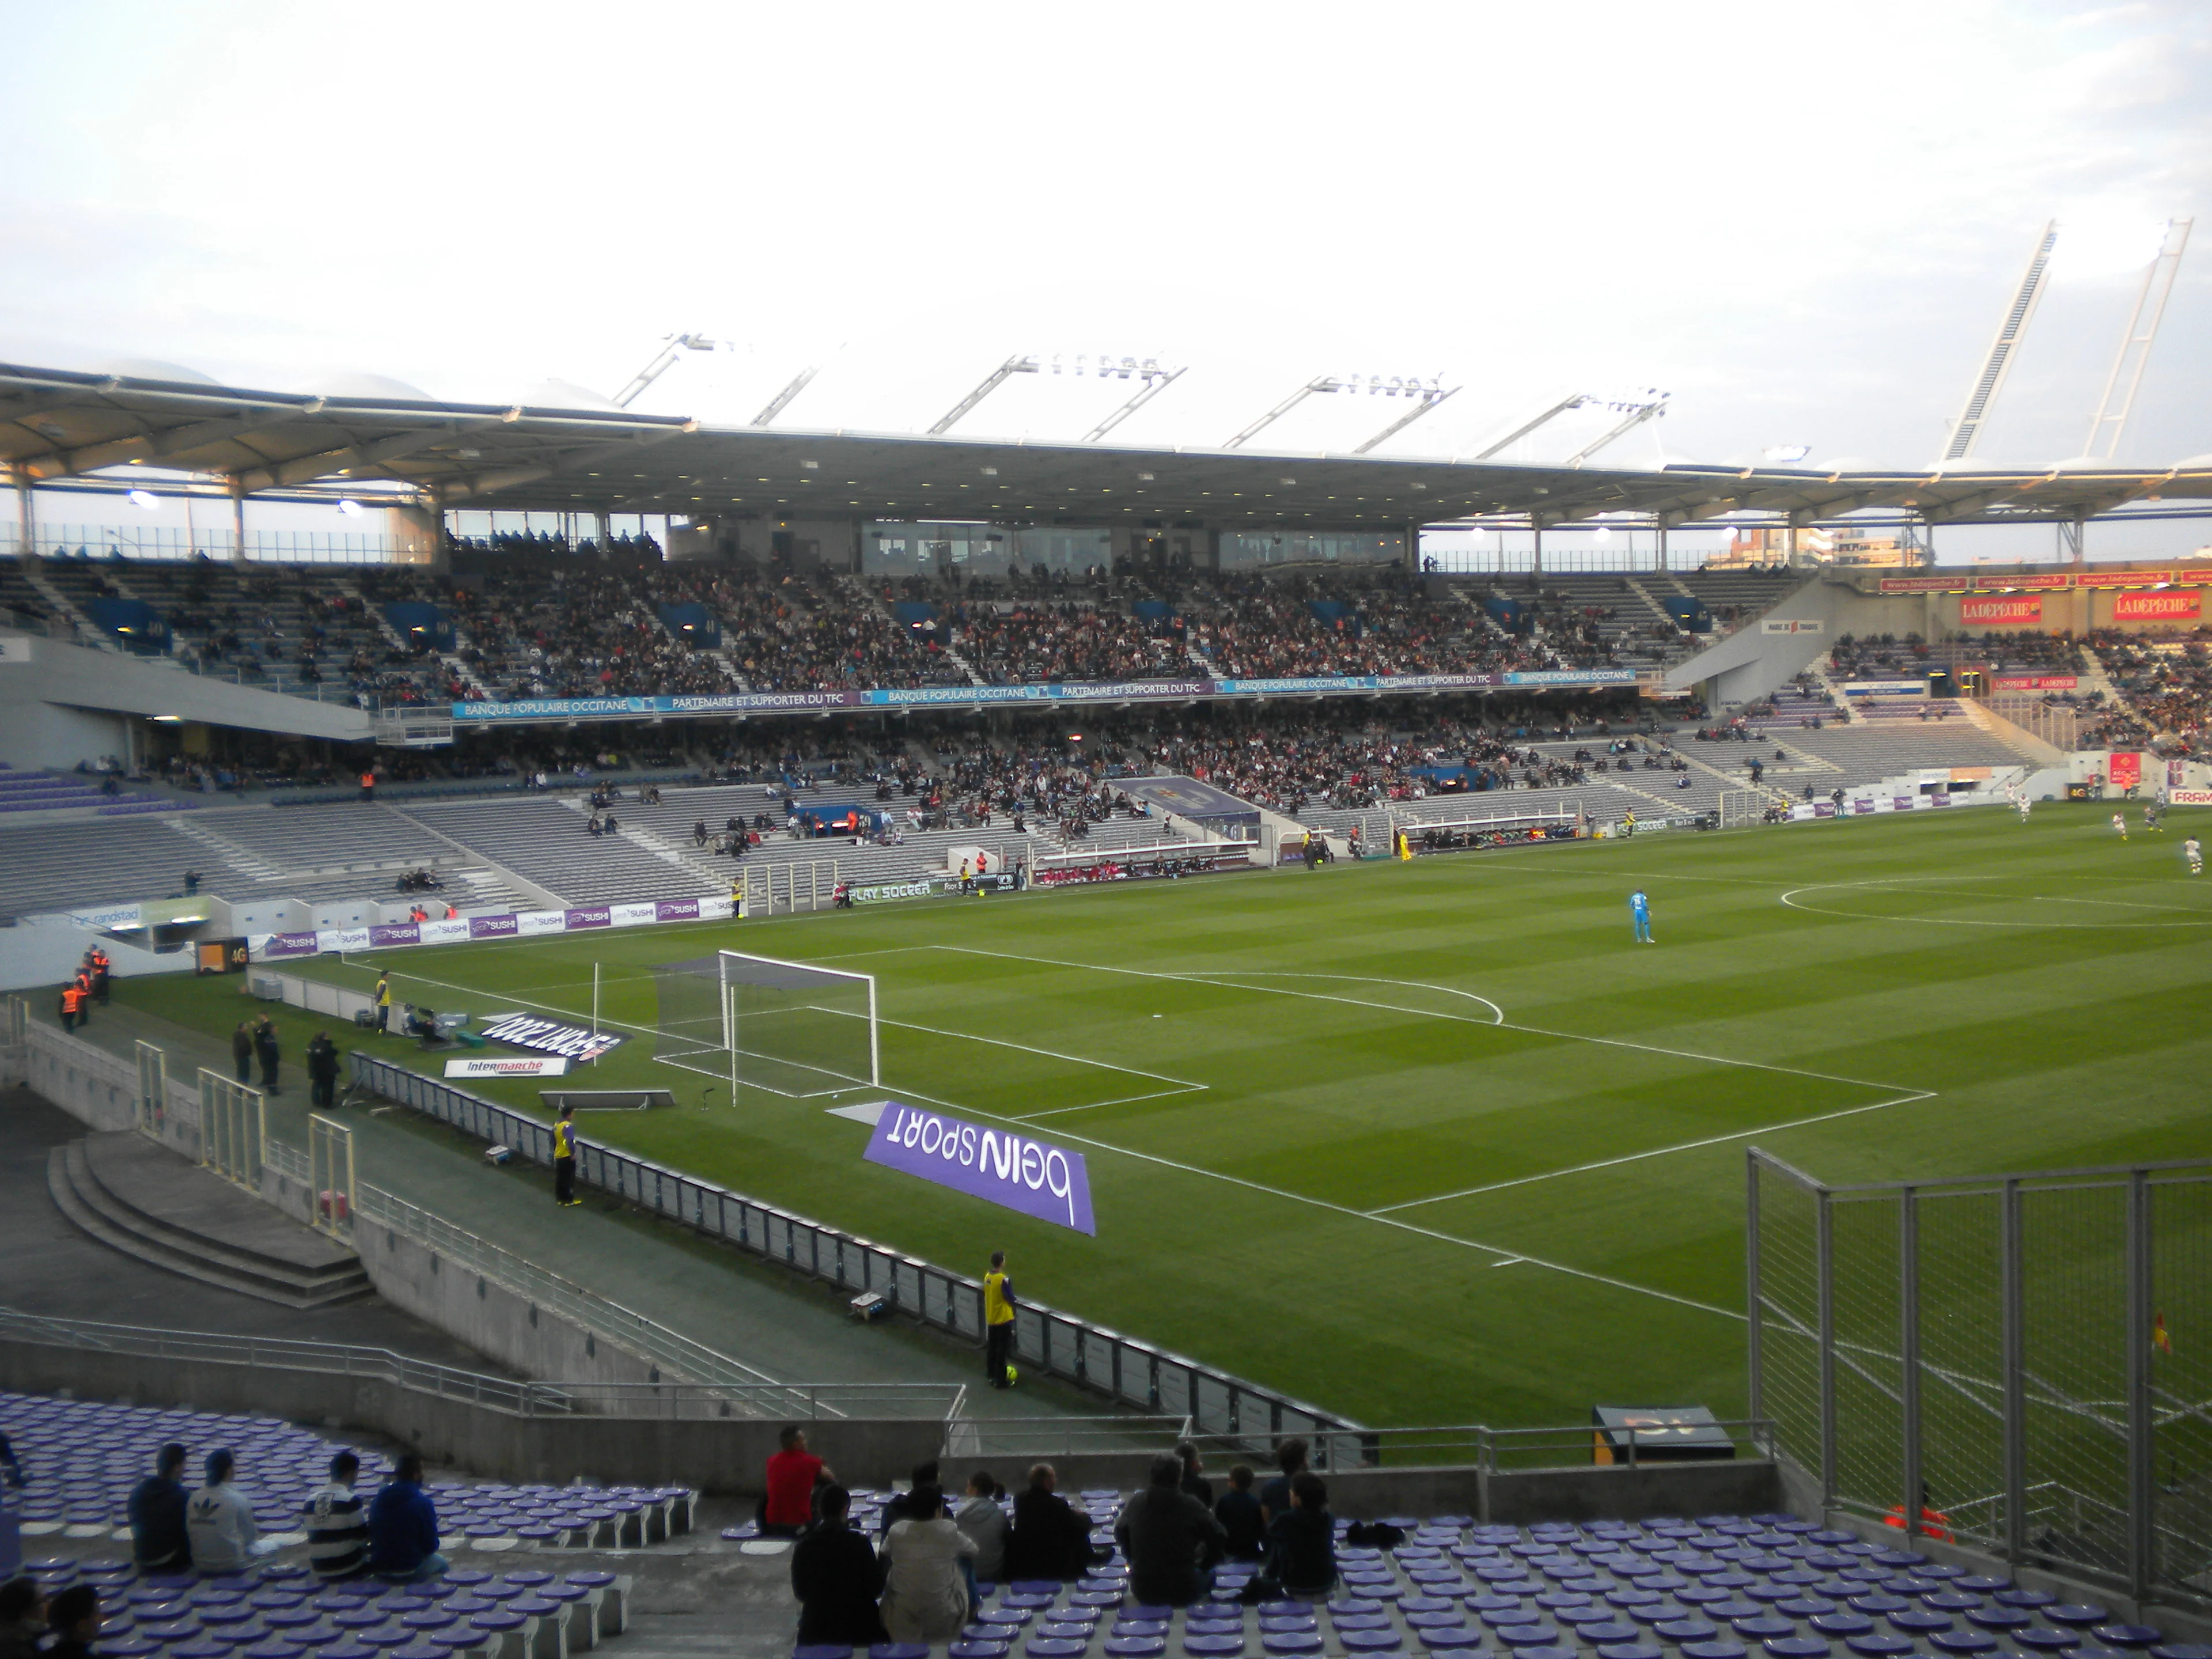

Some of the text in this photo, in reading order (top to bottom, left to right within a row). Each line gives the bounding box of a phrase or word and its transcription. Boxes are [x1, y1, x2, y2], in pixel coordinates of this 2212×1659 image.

[1376, 675, 1490, 686] PARTENAIRE ET SUPPORTER DU TFC
[1522, 671, 1628, 682] BANQUE POPULAIRE OCCITANE
[1062, 683, 1200, 696] PARTENAIRE ET SUPPORTER DU TFC
[1236, 679, 1346, 691] BANQUE POPULAIRE OCCITANE
[889, 688, 1025, 702] BANQUE POPULAIRE OCCITANE
[672, 694, 843, 708] PARTENAIRE ET SUPPORTER DU TFC
[465, 700, 627, 716] BANQUE POPULAIRE OCCITANE
[631, 908, 654, 917] SUSHI
[674, 904, 698, 914] SUSHI
[94, 909, 139, 923] randstad
[539, 917, 562, 926] SUSHI
[585, 912, 608, 922] SUSHI
[442, 925, 467, 934] SUSHI
[490, 921, 516, 930] SUSHI
[340, 934, 367, 944] SUSHI
[391, 929, 418, 939] SUSHI
[287, 938, 315, 948] SUSHI
[232, 948, 248, 964] 4G
[467, 1060, 543, 1071] Intermarché
[886, 1108, 977, 1166] SPORT
